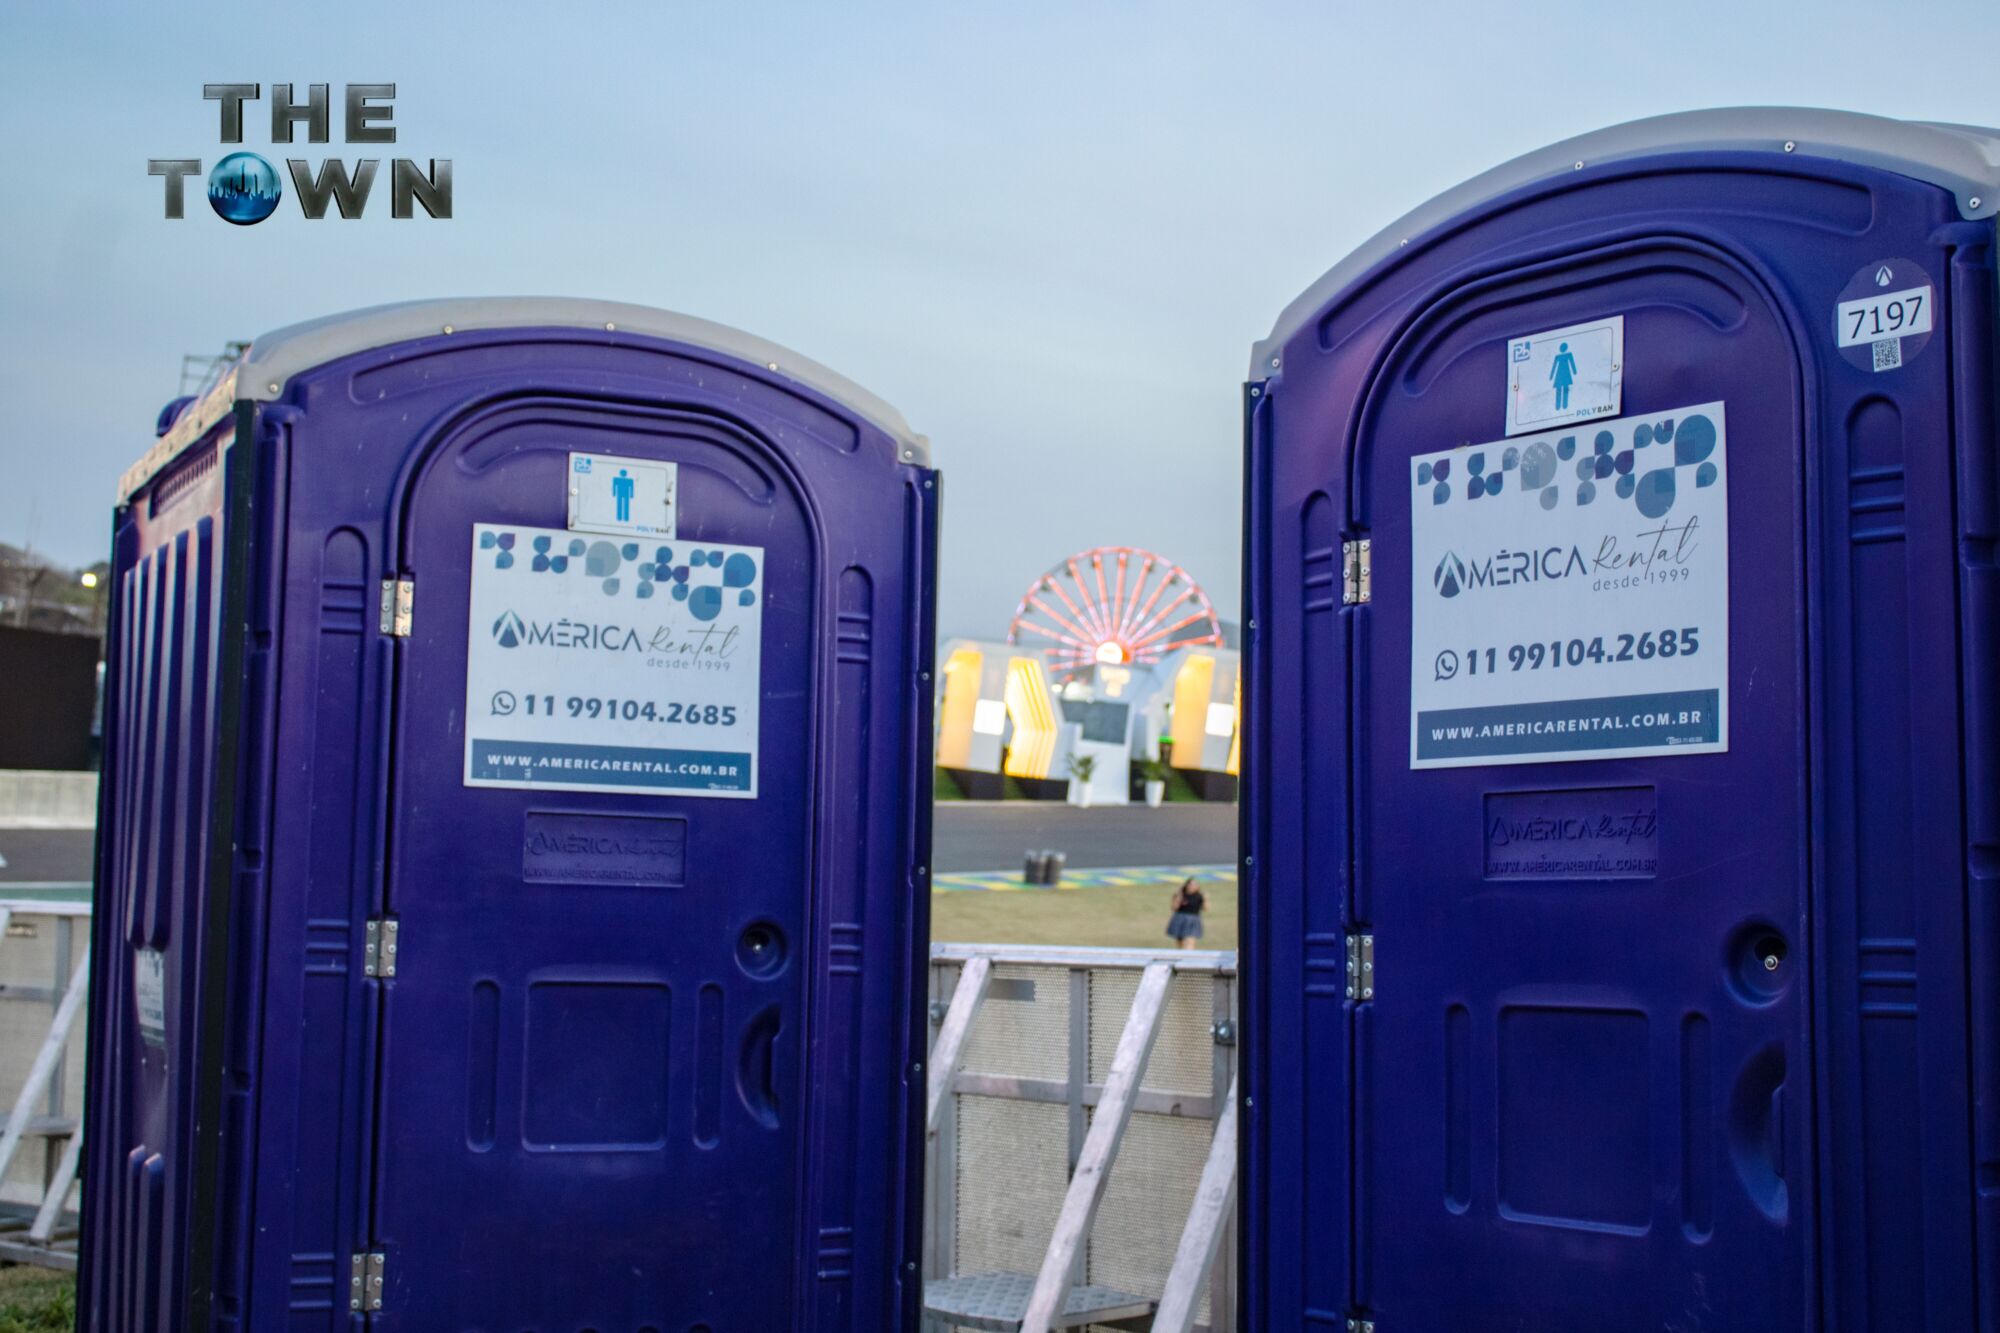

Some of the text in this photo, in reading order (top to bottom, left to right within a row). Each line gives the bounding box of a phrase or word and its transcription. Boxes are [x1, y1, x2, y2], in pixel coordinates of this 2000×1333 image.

[1848, 295, 1923, 339] 7197
[1576, 403, 1614, 417] POLYBAN
[1592, 515, 1701, 580] Rental
[1592, 567, 1690, 592] desde 1999
[647, 623, 740, 665] Rental
[1466, 627, 1700, 675] 11 99104.2685
[647, 657, 731, 672] desde 1999
[525, 694, 737, 727] 11 99104.2685
[1431, 711, 1702, 741] WWW.AMERICARENTAL.COM.BR
[487, 754, 738, 777] WWW.AMERICARENTAL.COM.BR
